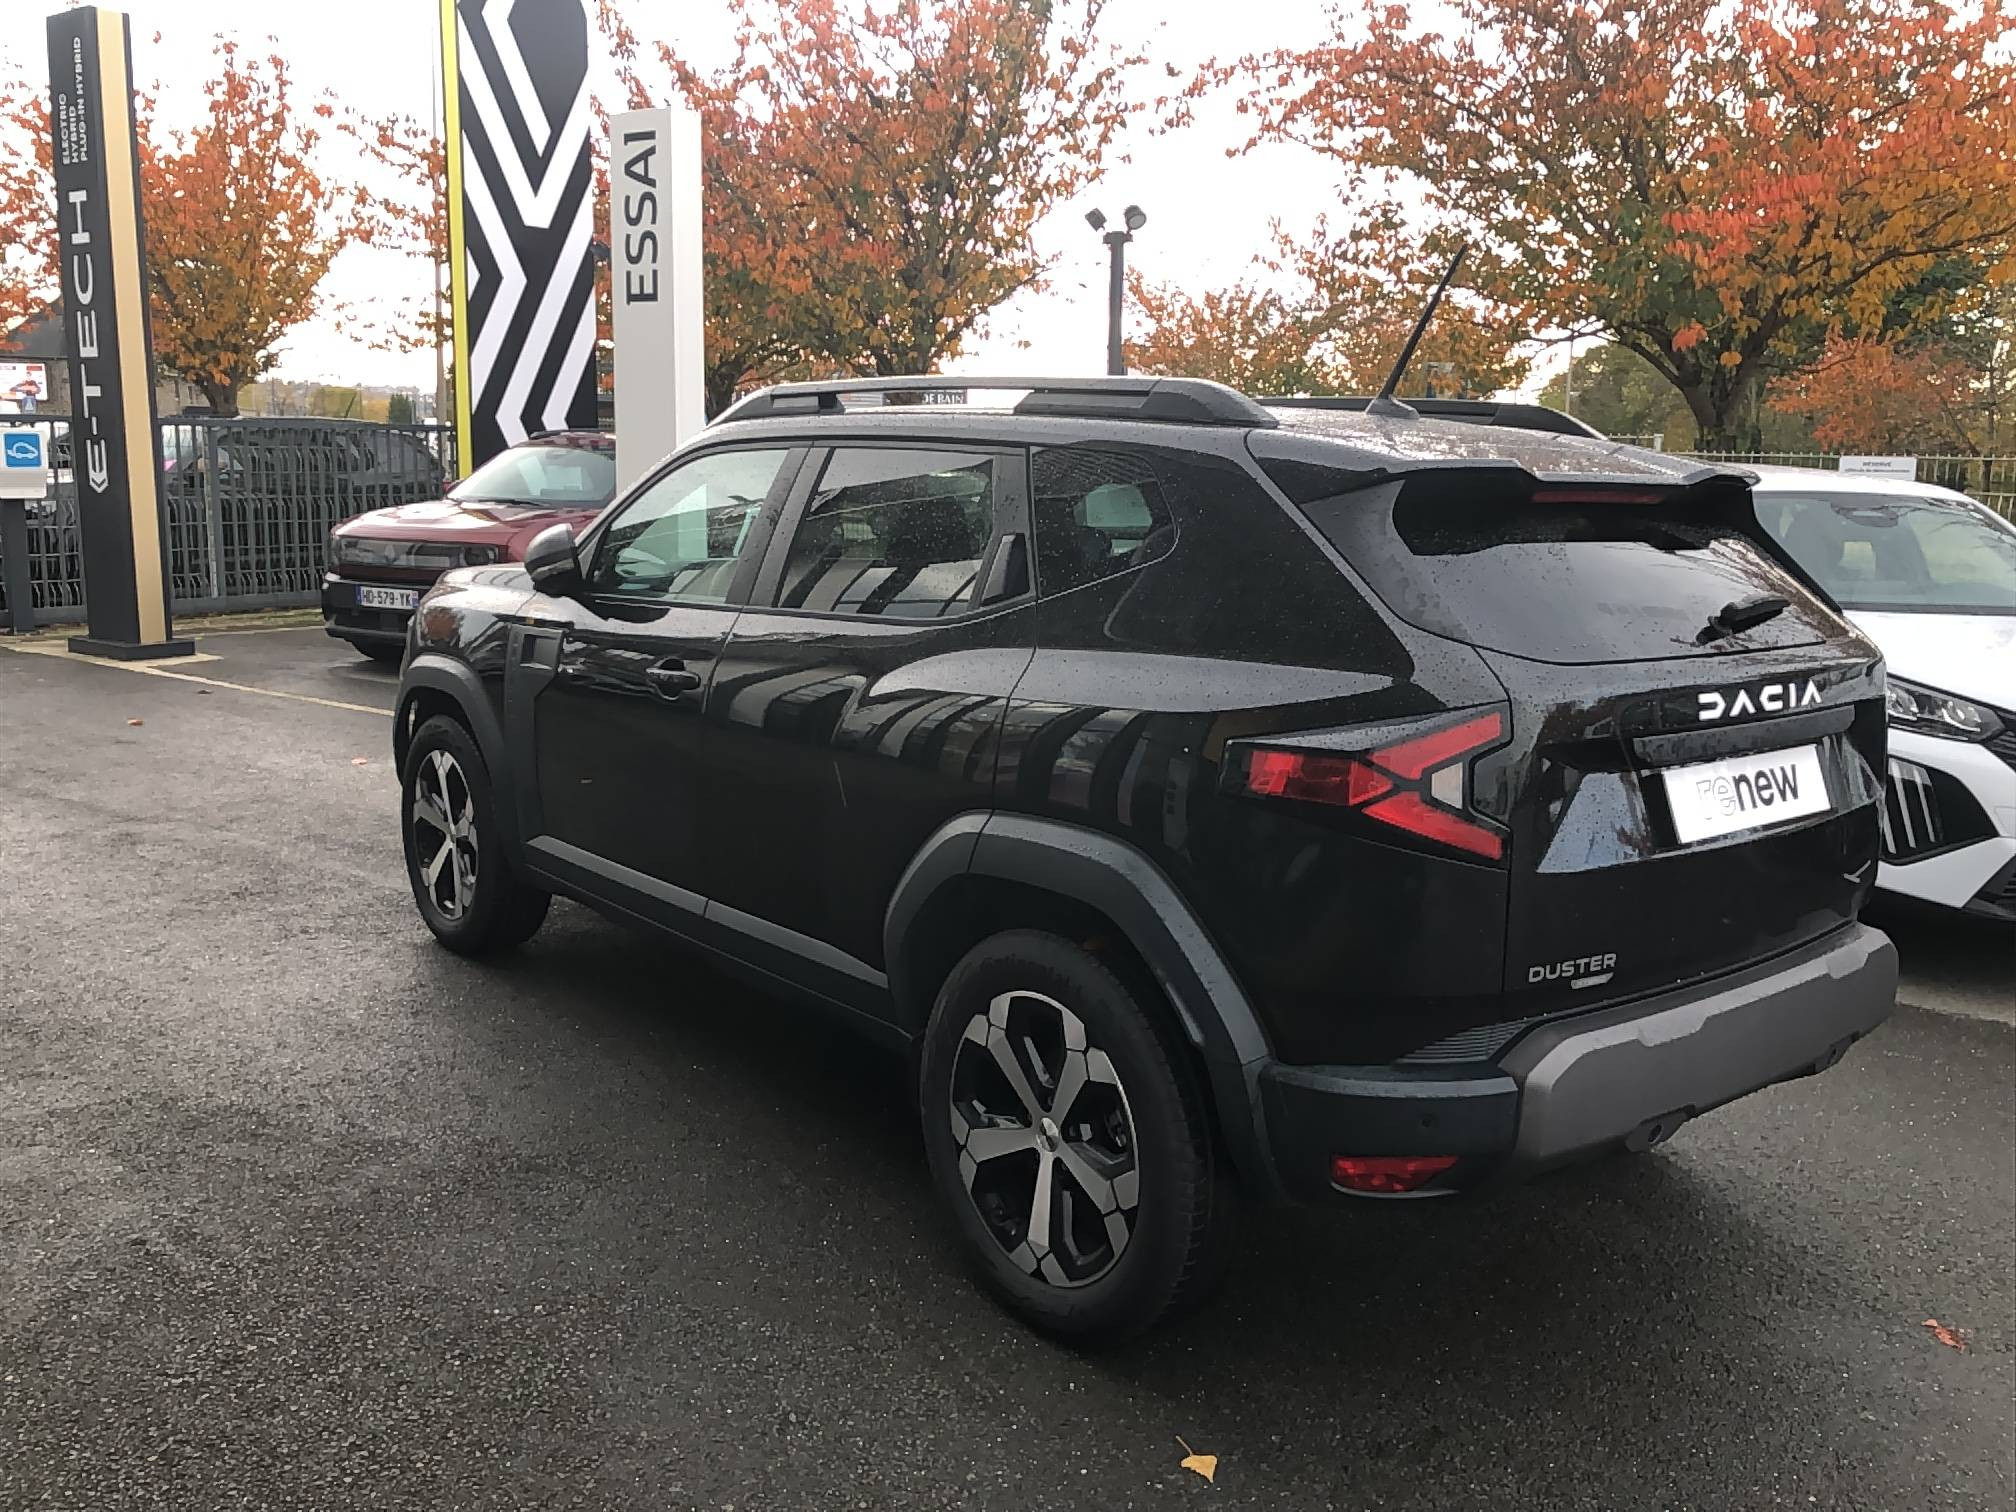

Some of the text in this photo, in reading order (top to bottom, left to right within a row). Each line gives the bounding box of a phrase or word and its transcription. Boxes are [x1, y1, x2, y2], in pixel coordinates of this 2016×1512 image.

[58, 93, 70, 164] ELECTRIC
[73, 37, 89, 162] PLUG-IN HYBRID
[69, 105, 79, 163] HYBRID
[624, 130, 658, 305] ESSAI
[67, 189, 109, 493] E-TECH
[362, 589, 411, 607] HD-579-YK
[1698, 679, 1822, 721] DACIA
[1696, 763, 1799, 821] renew
[1528, 953, 1617, 983] DUSTER
